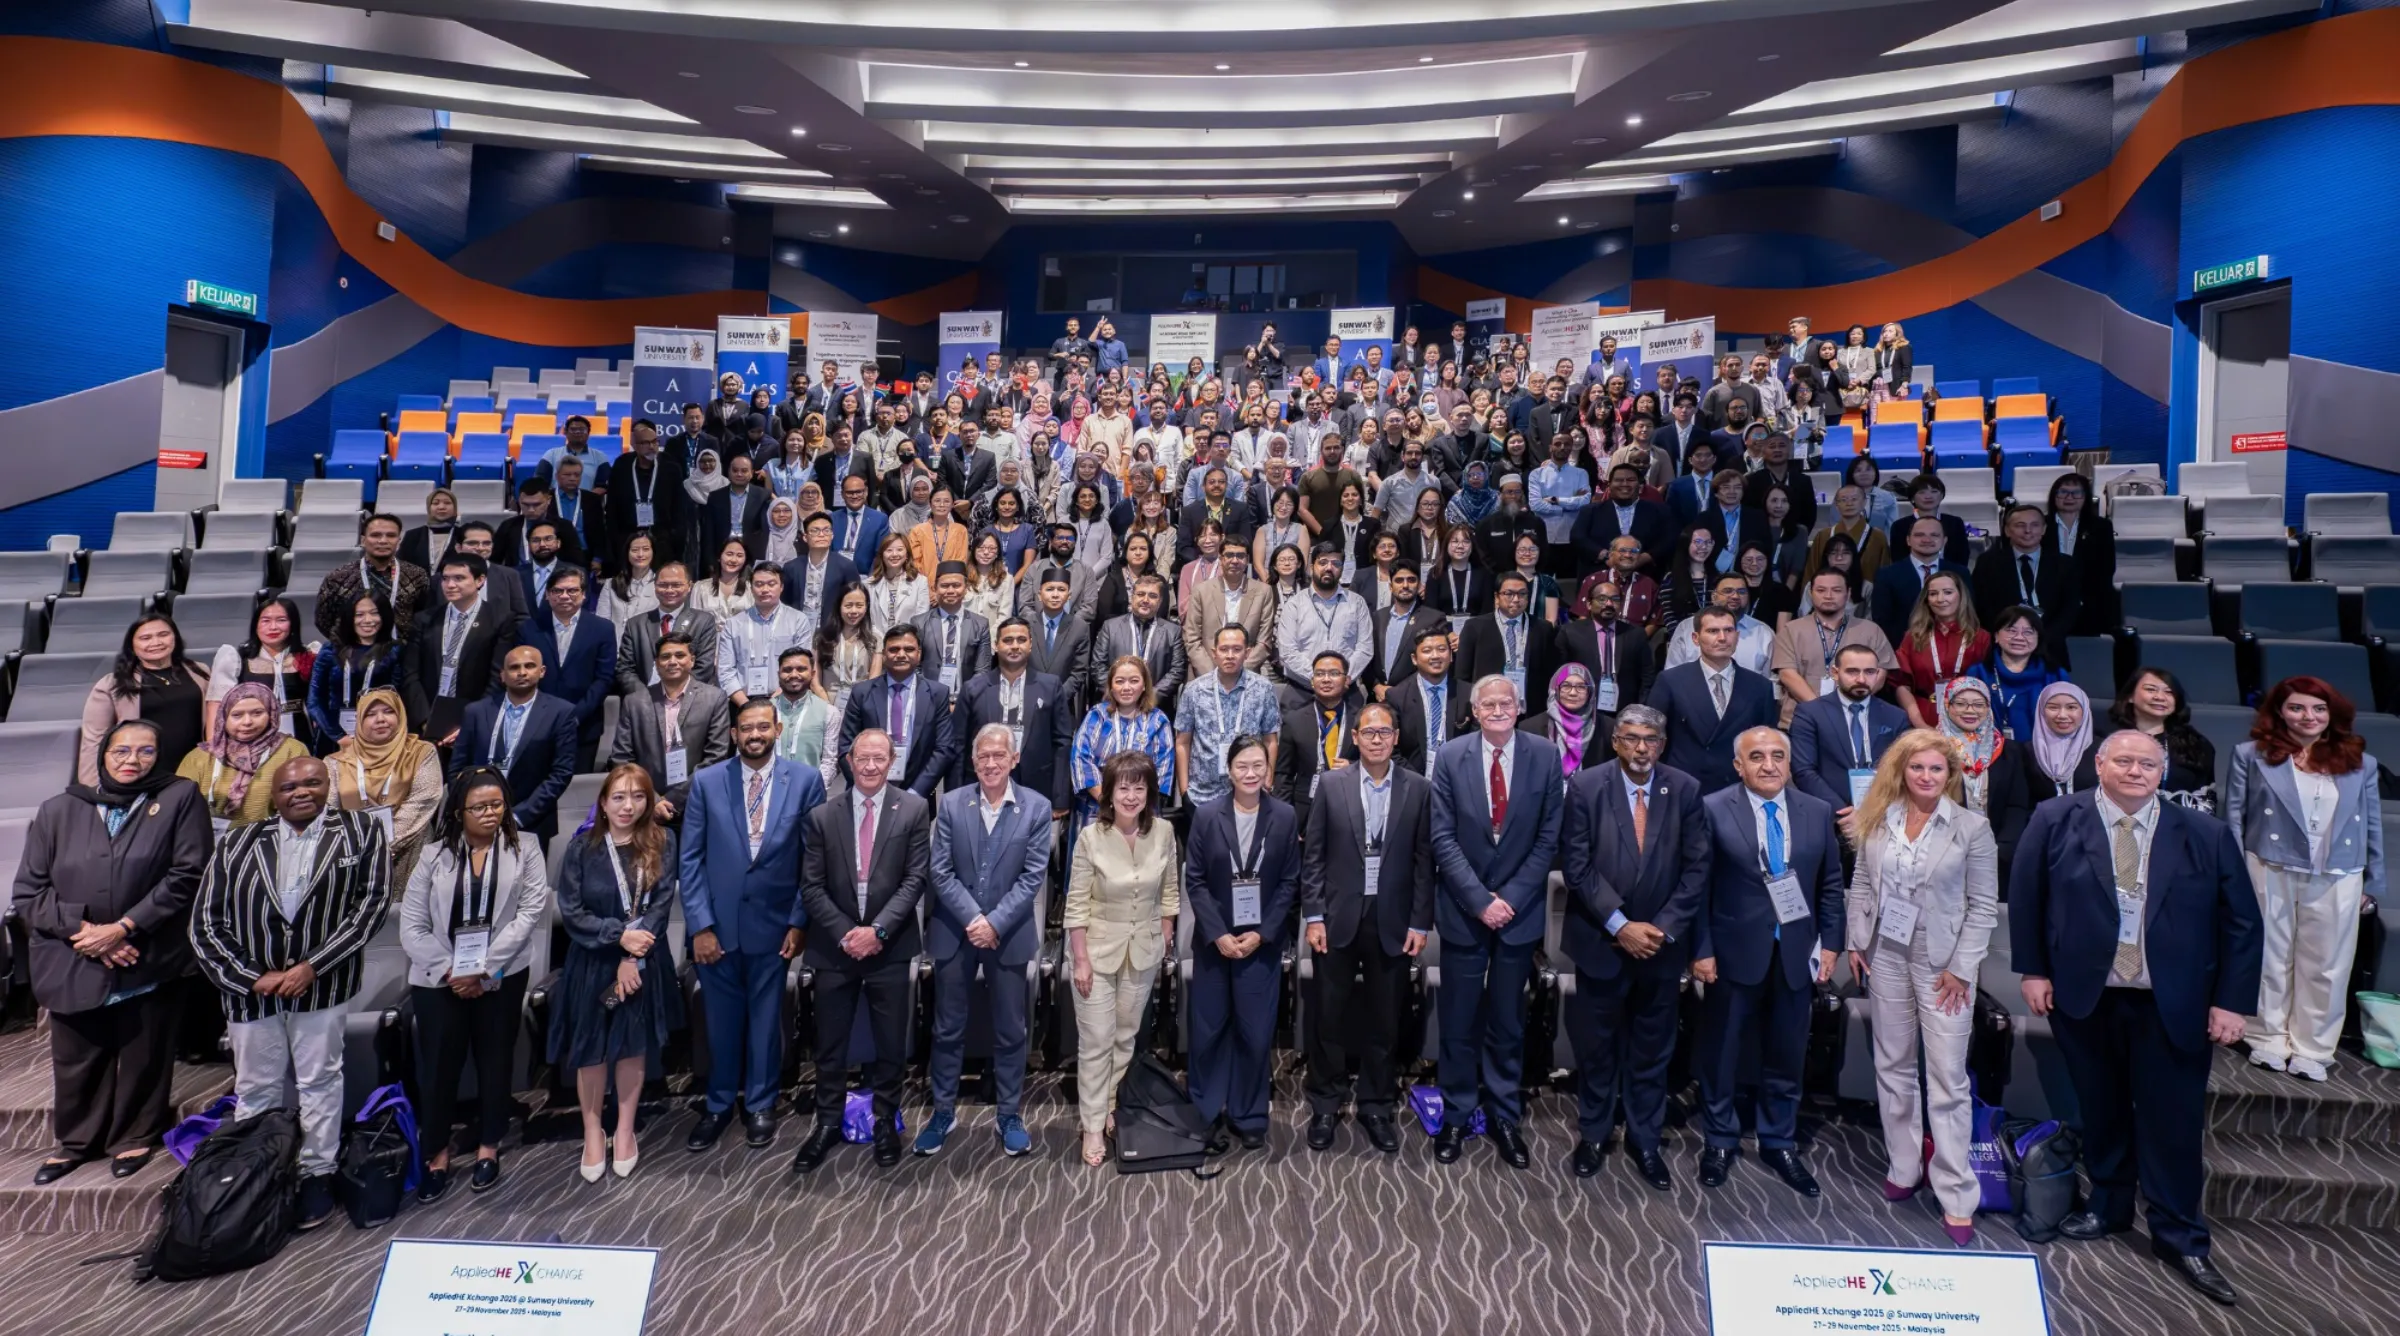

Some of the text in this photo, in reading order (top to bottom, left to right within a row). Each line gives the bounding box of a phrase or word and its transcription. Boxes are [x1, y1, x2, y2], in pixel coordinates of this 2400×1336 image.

[2200, 264, 2244, 287] KELUAR
[200, 285, 241, 308] KELUAR
[1338, 321, 1372, 329] SUNWAY
[727, 331, 766, 340] SUNWAY
[1600, 328, 1639, 338] SUNWAY
[644, 345, 688, 354] SUNWAY
[1648, 337, 1688, 350] SUNWAY
[644, 353, 688, 361] UNIVERSITY
[1354, 348, 1366, 360] A
[1648, 345, 1688, 356] UNIVERSITY
[746, 361, 760, 375] A
[665, 378, 680, 392] A
[451, 1265, 513, 1279] AppliedHE
[1793, 1274, 1867, 1290] AppliedHE
[429, 1292, 595, 1308] AppliedHE Xchange 2025 @ Sunway University
[475, 1307, 510, 1315] November
[531, 1309, 562, 1319] Malaysia
[1775, 1305, 1980, 1323] AppliedHE Xchange 2025 @ Sunway University
[1837, 1322, 1880, 1332] November
[1881, 1323, 1902, 1332] 2025
[1907, 1325, 1946, 1335] Malaysia
